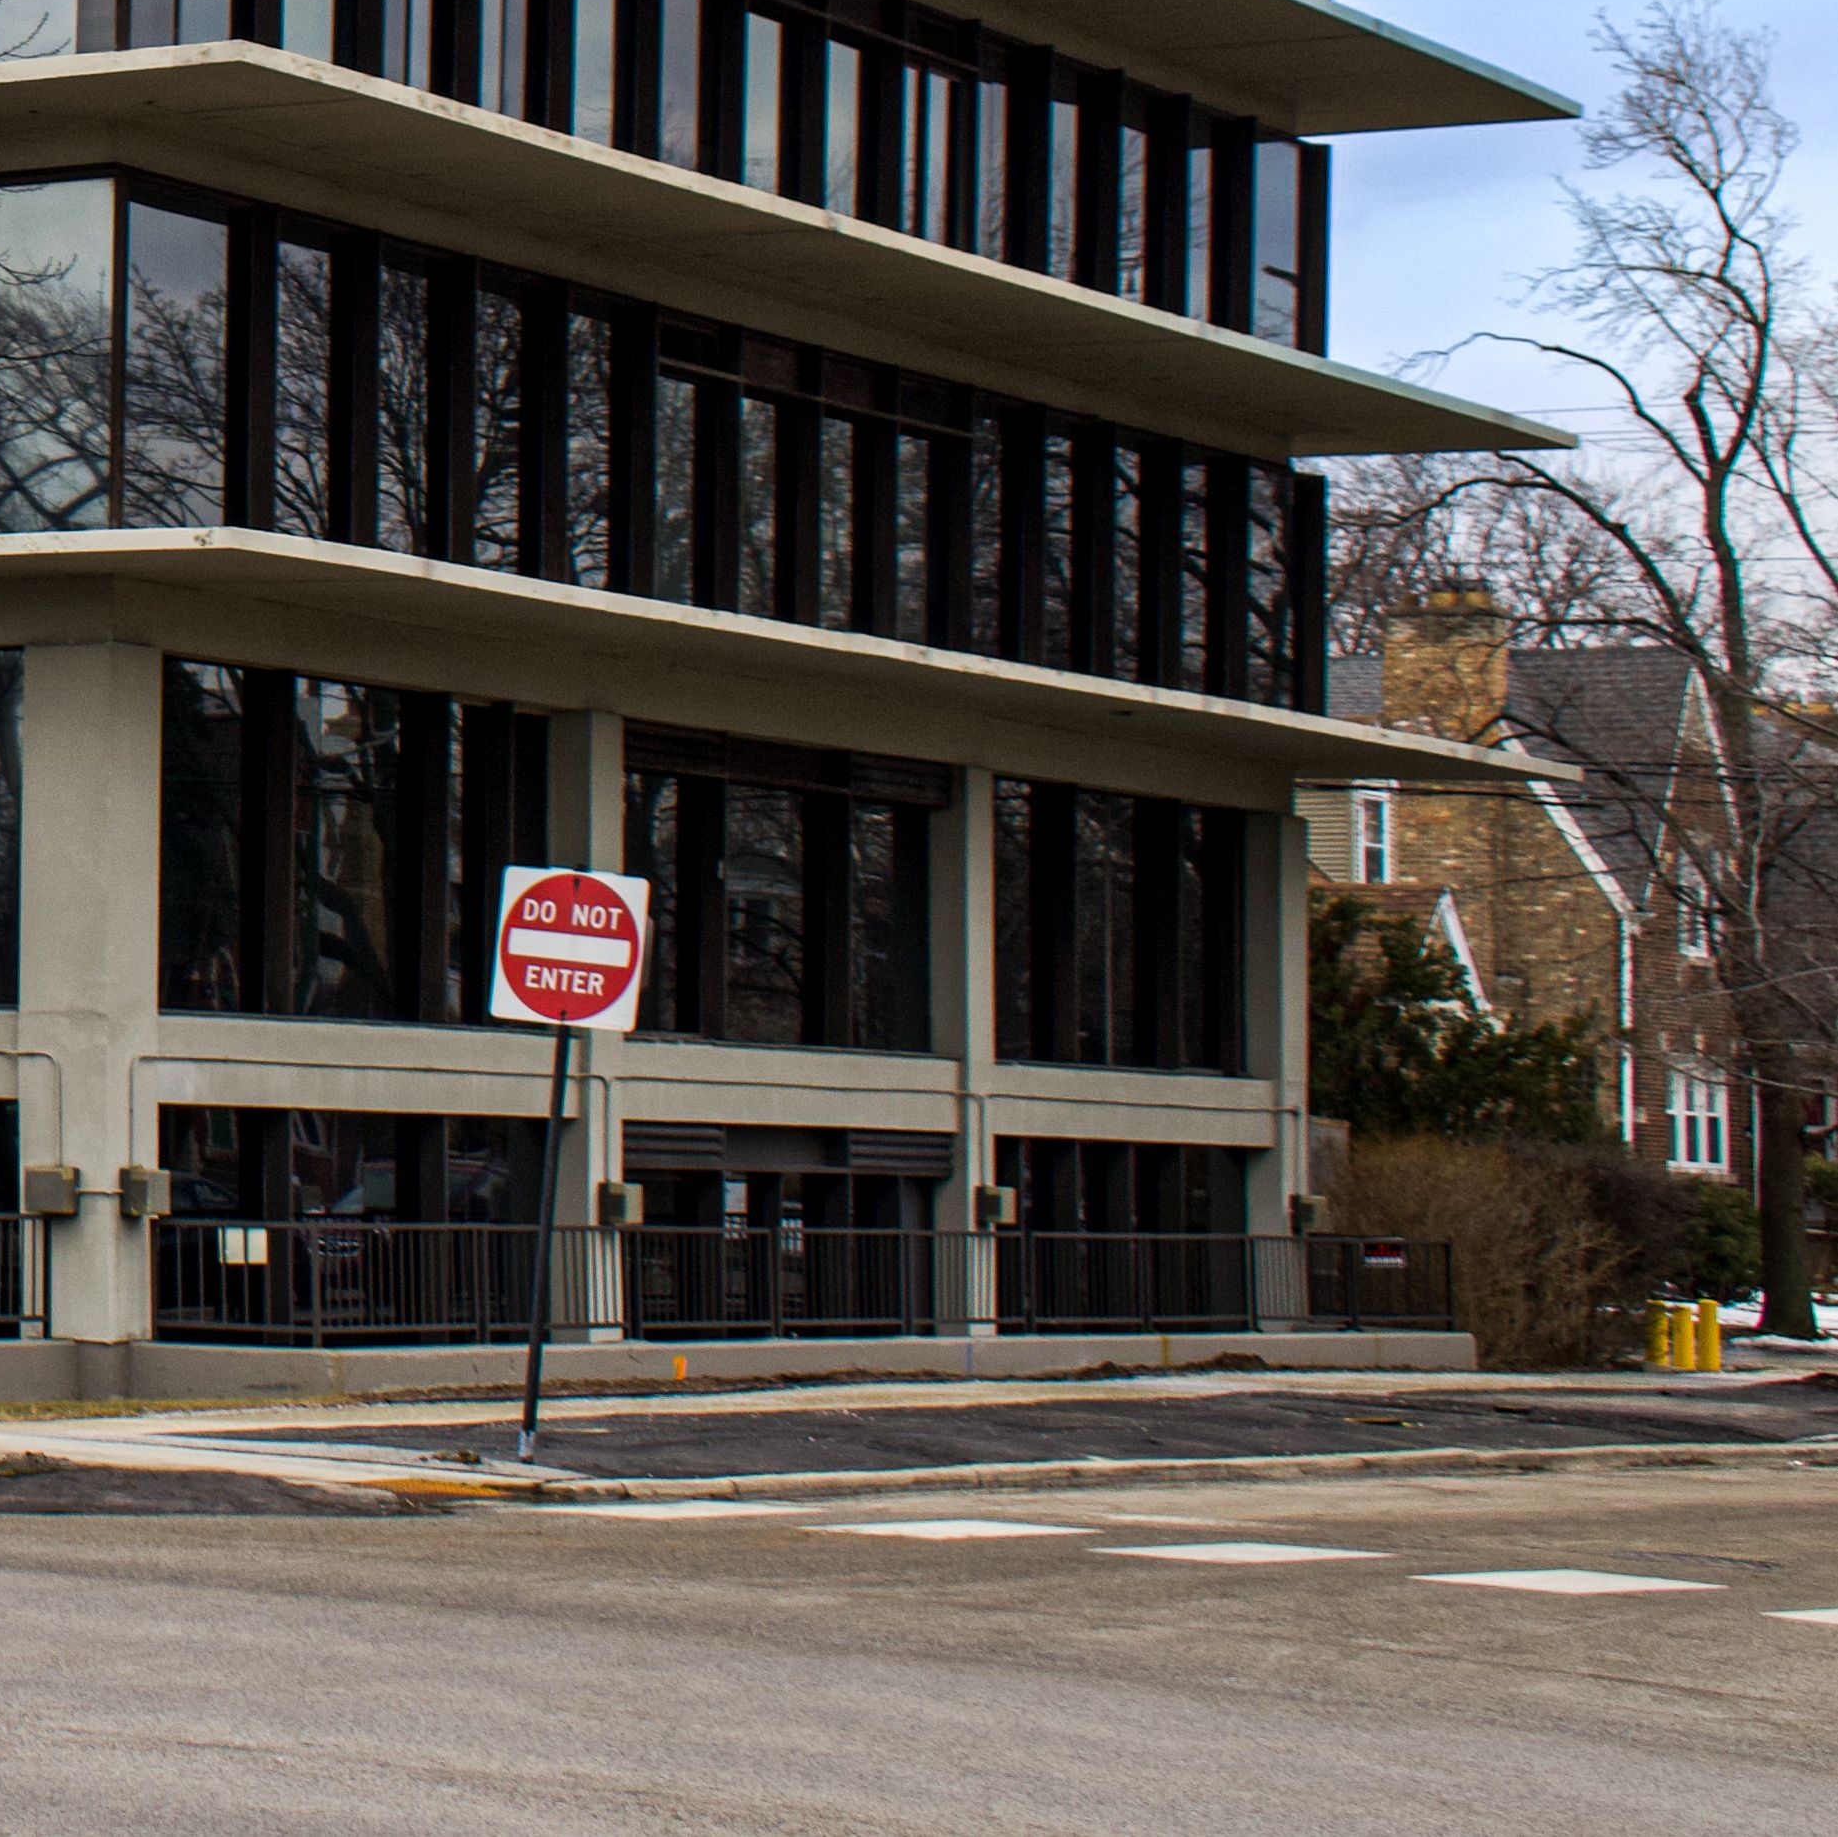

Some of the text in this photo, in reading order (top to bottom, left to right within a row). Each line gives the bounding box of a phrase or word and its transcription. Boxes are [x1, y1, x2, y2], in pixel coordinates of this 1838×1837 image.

[522, 898, 623, 930] DO NOT
[525, 965, 605, 996] ENTER
